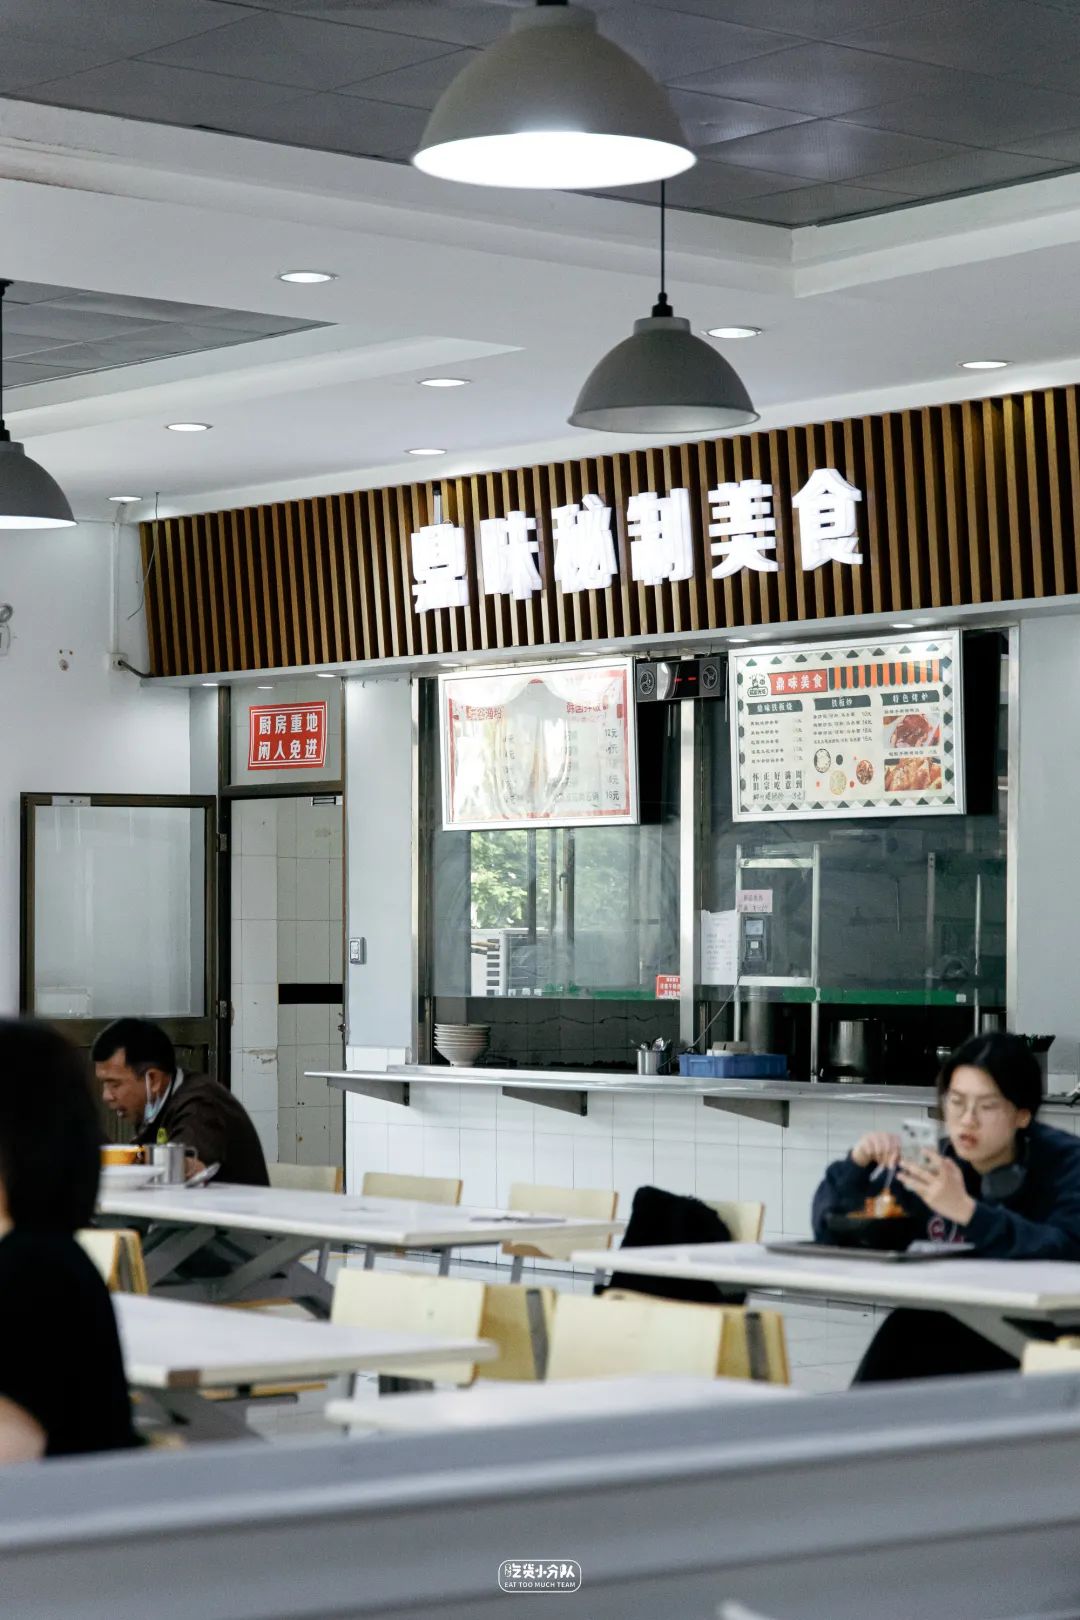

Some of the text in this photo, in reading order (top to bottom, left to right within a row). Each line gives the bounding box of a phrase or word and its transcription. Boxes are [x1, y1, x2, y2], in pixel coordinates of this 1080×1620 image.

[775, 673, 823, 691] 鼎味美食
[259, 713, 318, 735] 厨房重地
[257, 738, 318, 761] 闲人免进
